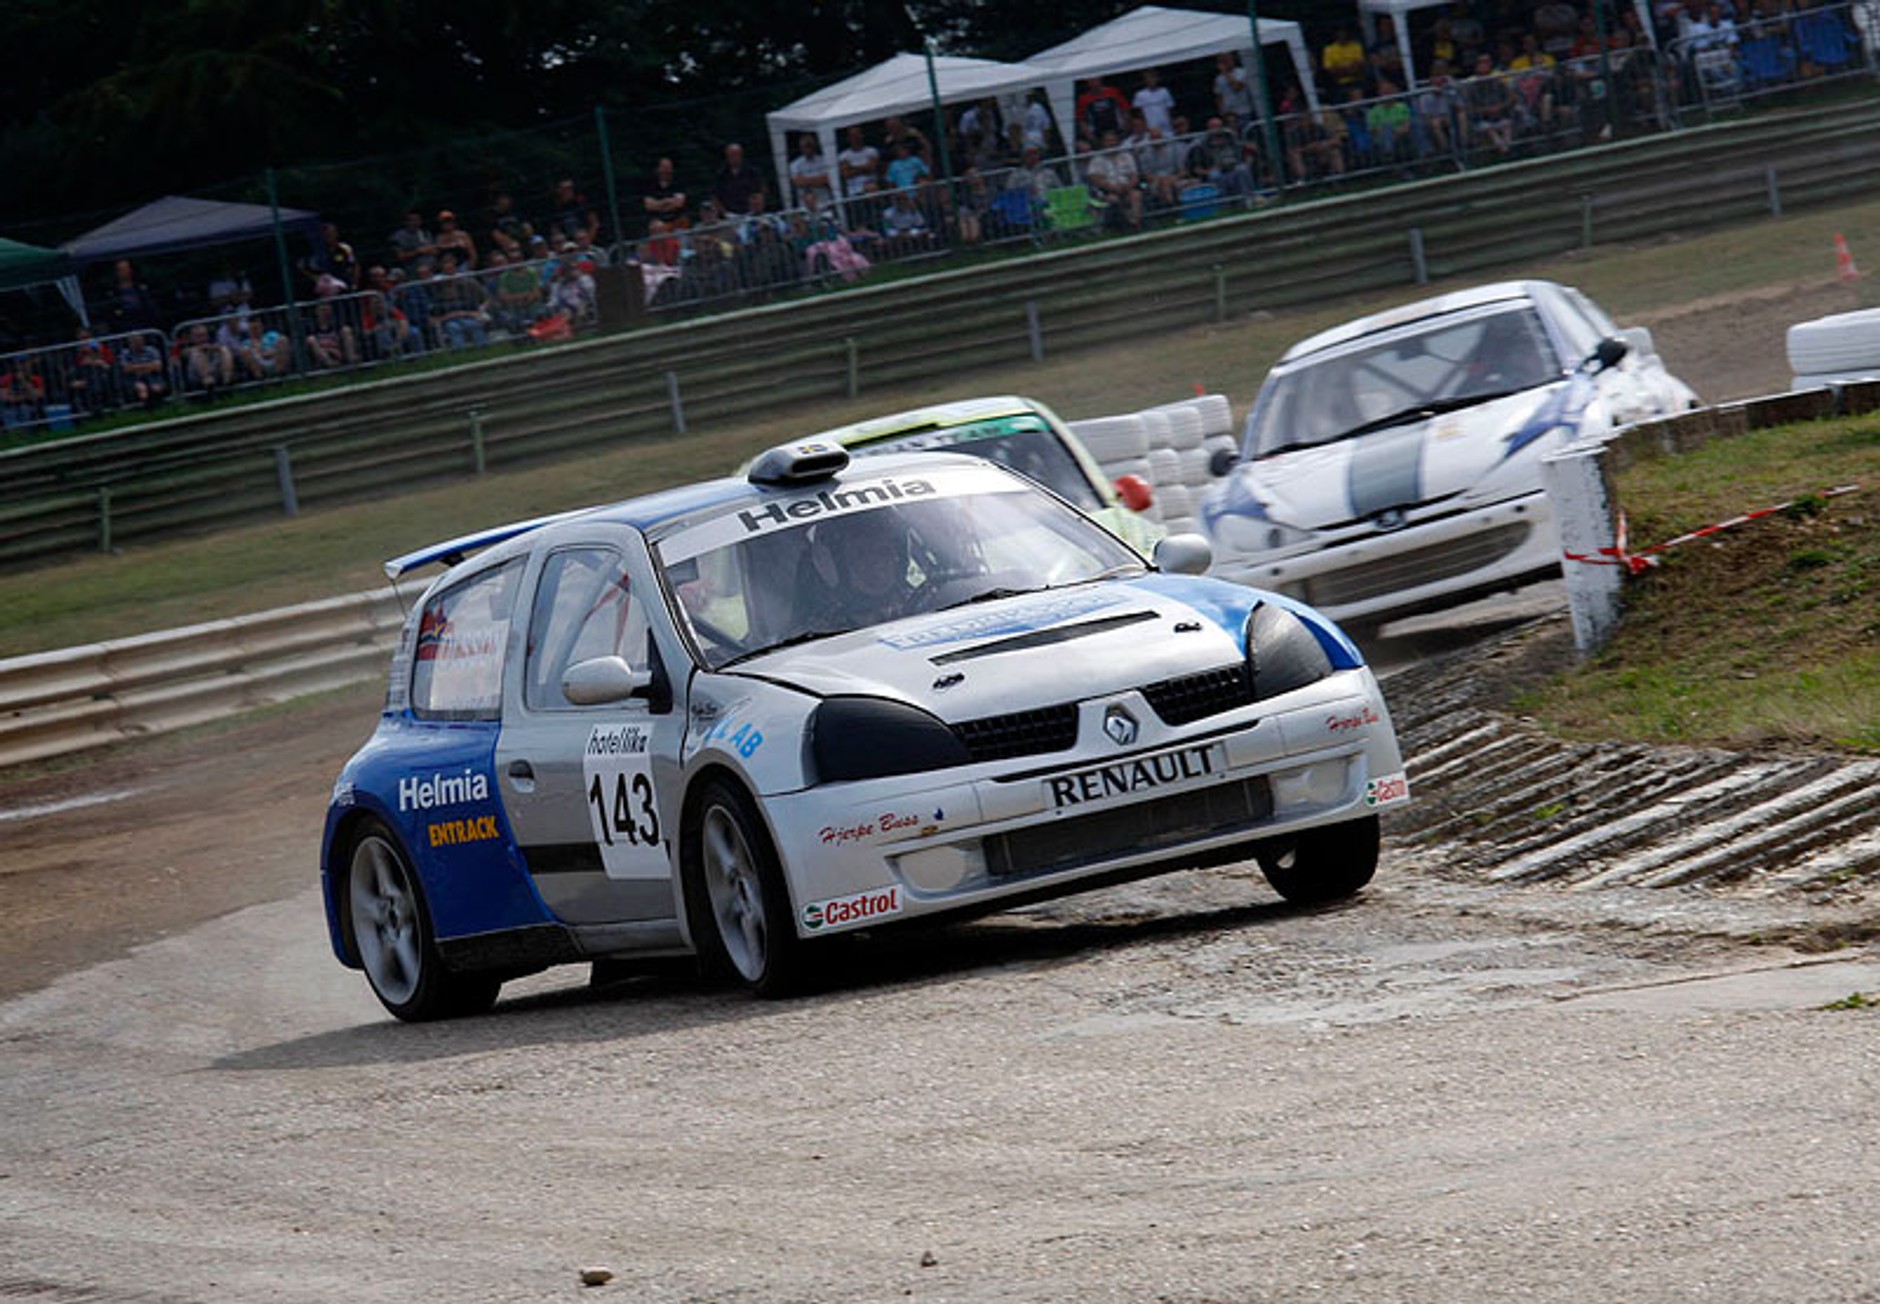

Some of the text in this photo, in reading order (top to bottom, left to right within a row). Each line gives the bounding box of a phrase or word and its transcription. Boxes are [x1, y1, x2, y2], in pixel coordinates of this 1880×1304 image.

[738, 480, 936, 532] Helmia
[400, 768, 488, 811] Helmia
[1051, 745, 1214, 807] RENAULT
[428, 815, 500, 847] ENTRACK
[590, 773, 660, 847] 143
[826, 888, 898, 925] Castrol
